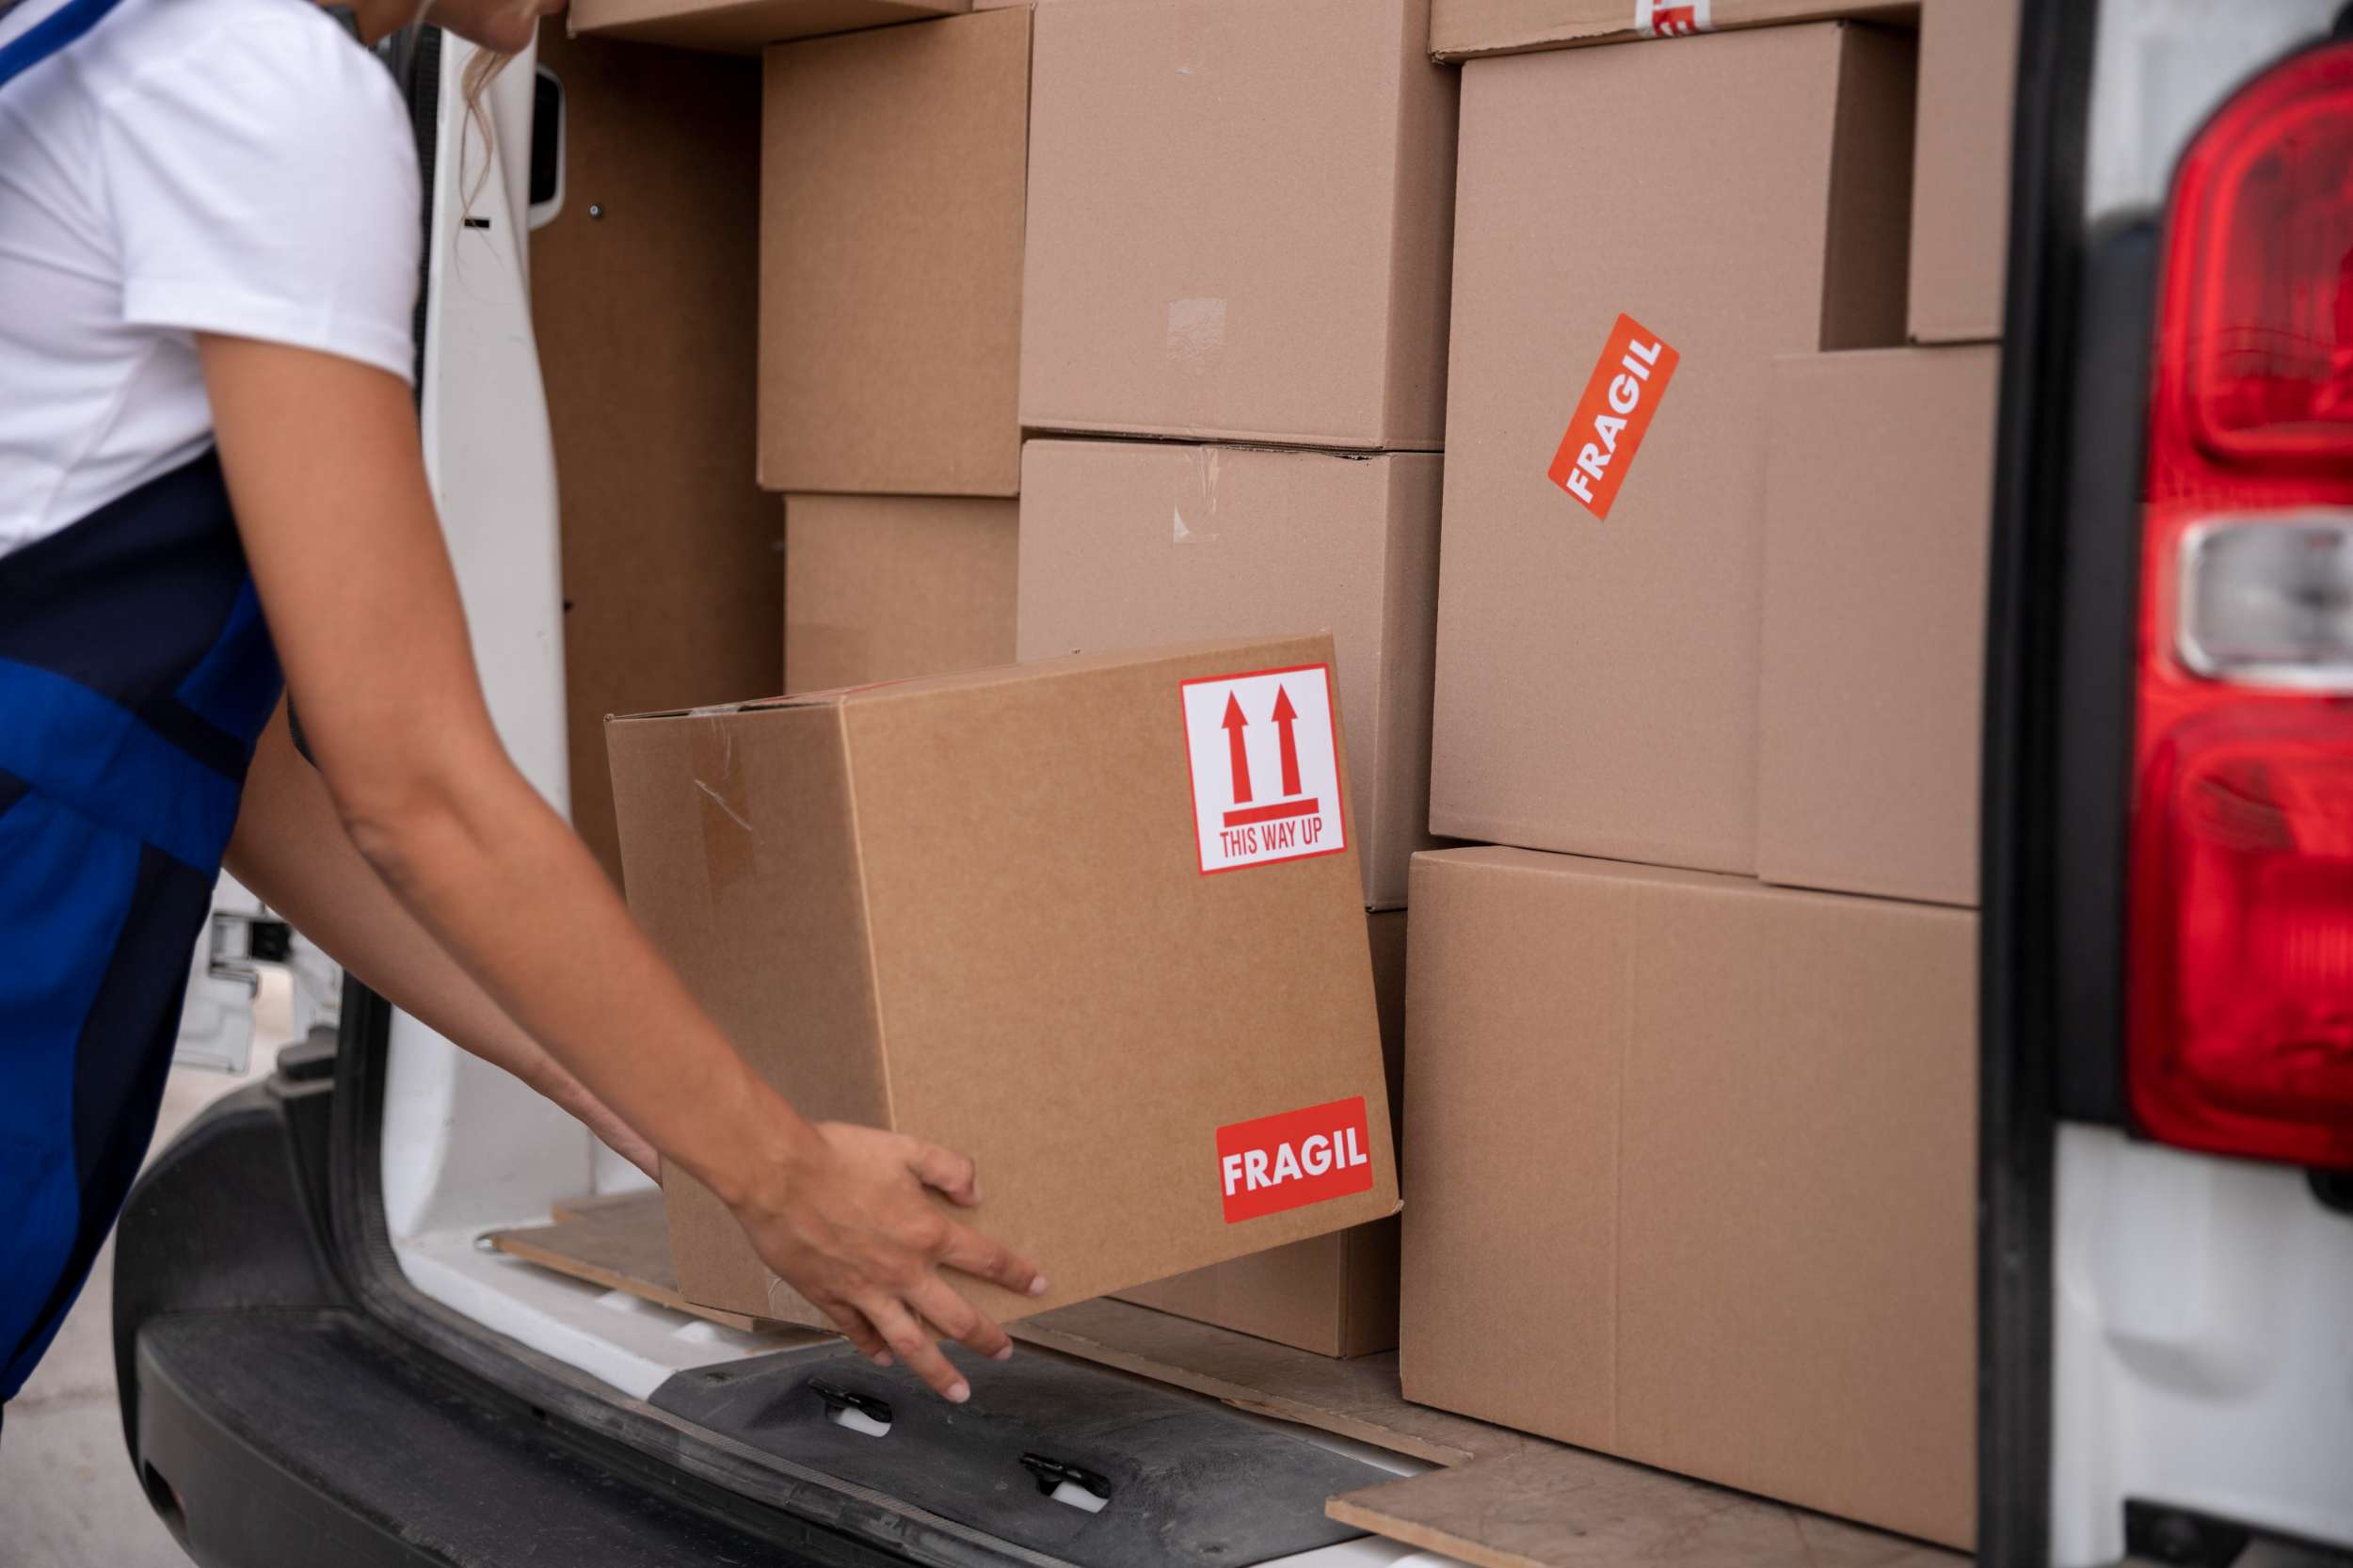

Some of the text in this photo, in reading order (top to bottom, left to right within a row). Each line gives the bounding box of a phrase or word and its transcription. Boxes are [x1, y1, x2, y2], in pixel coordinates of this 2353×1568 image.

[1565, 338, 1662, 504] FRAGIL
[1220, 817, 1322, 858] THIS WAY UP
[1222, 1127, 1368, 1196] FRAGIL
